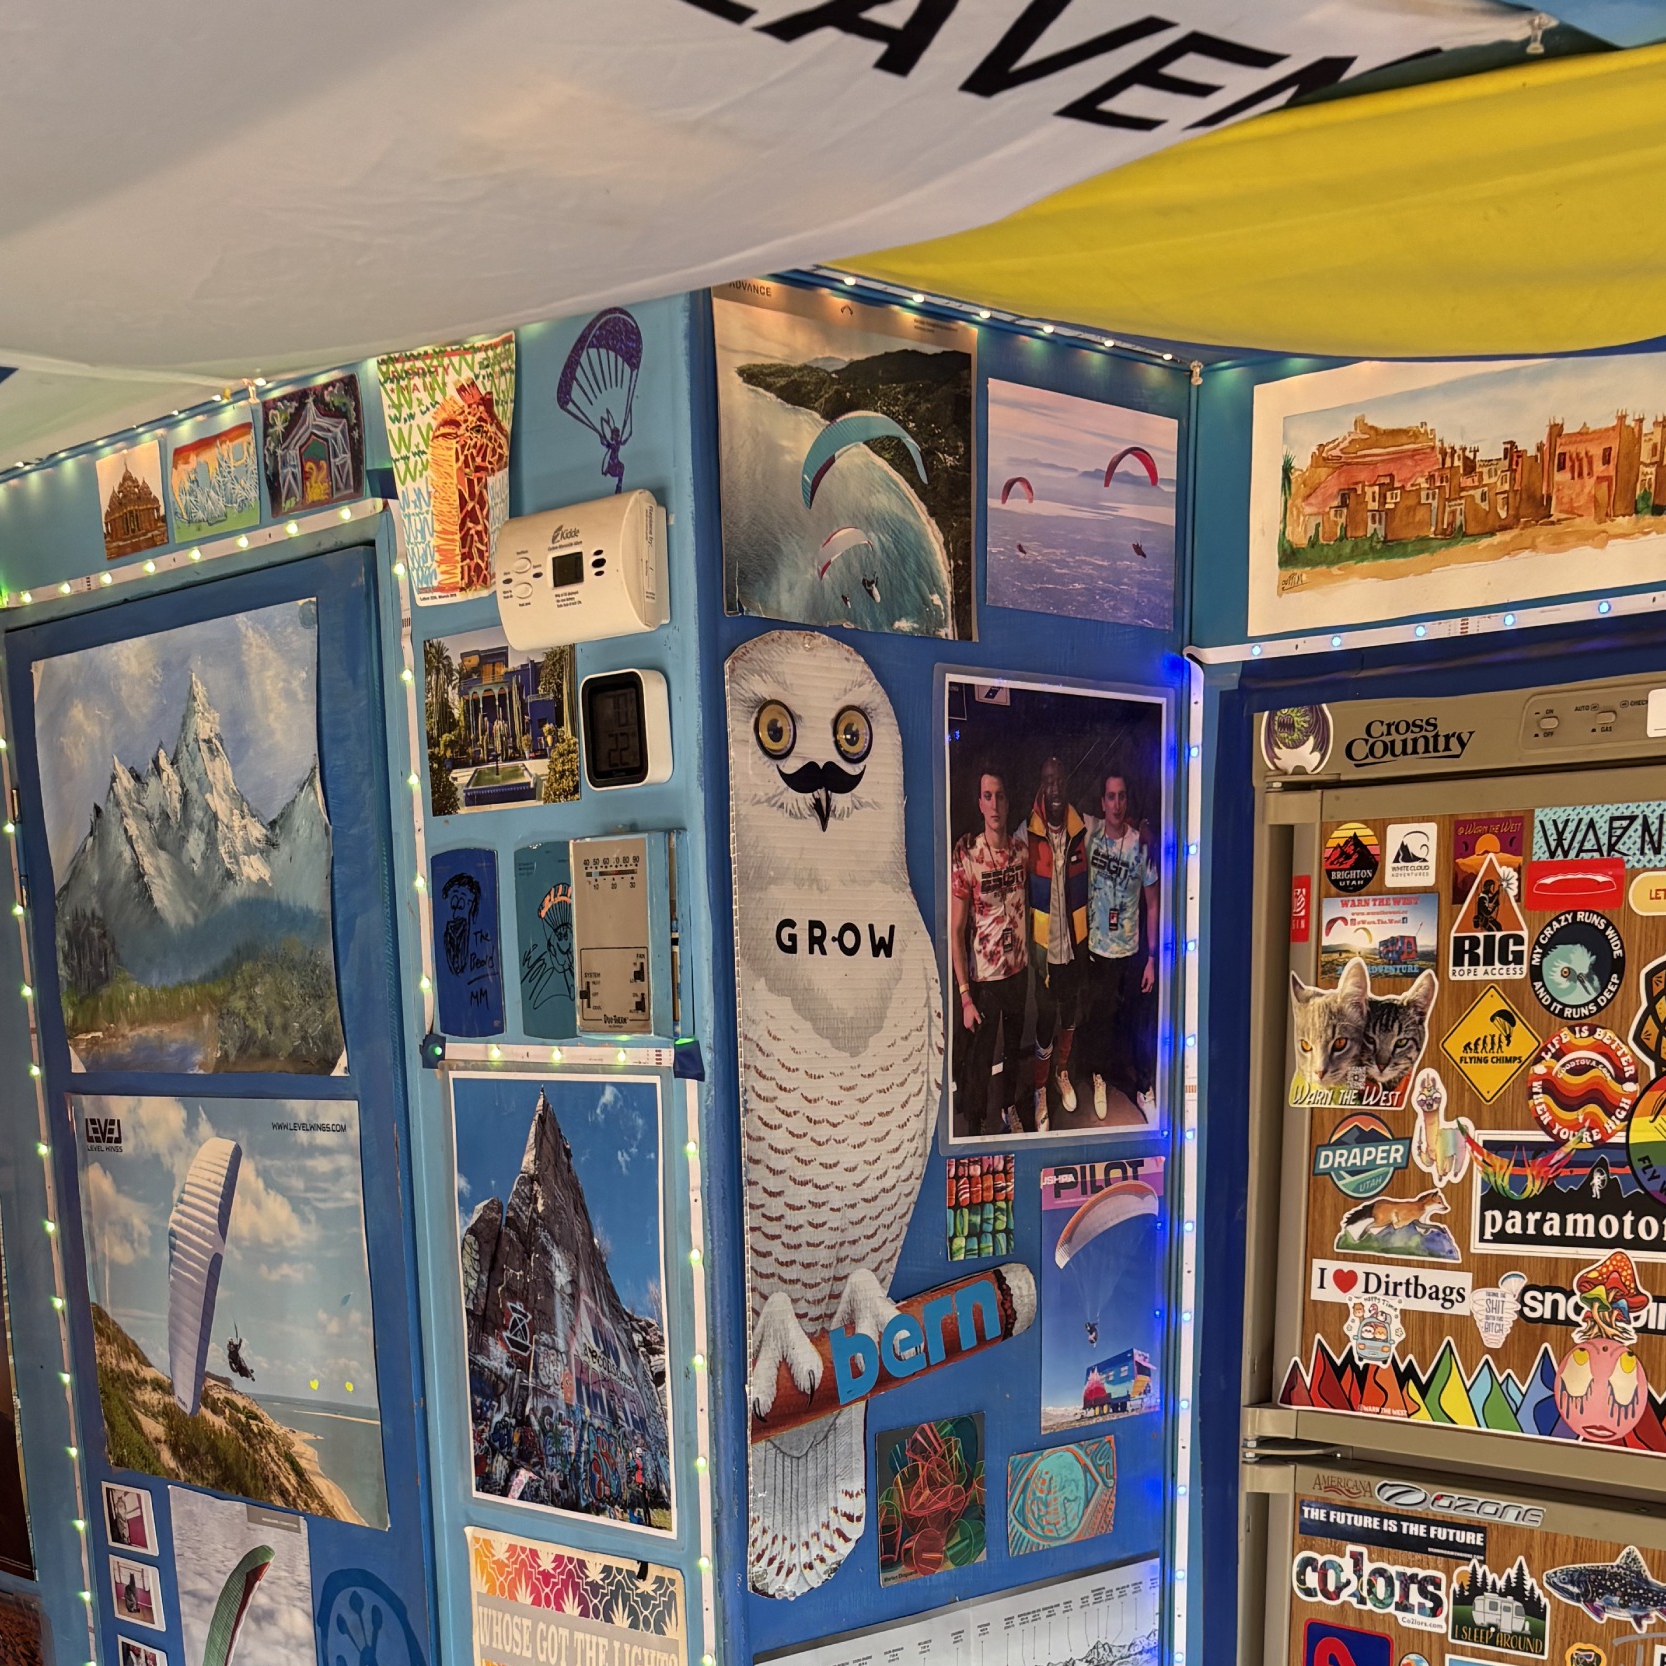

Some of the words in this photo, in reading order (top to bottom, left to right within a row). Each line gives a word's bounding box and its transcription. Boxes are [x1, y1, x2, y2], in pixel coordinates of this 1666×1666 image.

[561, 528, 579, 540] Kidde
[1366, 717, 1438, 738] Cross
[1346, 730, 1475, 765] Country
[623, 856, 630, 864] 80
[1331, 869, 1373, 881] BRIGHTON
[1341, 899, 1369, 908] WARN
[1372, 898, 1390, 907] THE
[1392, 897, 1419, 906] WEST
[473, 930, 491, 945] The
[776, 919, 895, 958] GROW
[1452, 934, 1524, 967] RIG
[1532, 946, 1543, 966] MY
[1539, 912, 1573, 944] CRAZY
[1577, 911, 1607, 929] RUNS
[1605, 926, 1623, 959] WIDE
[469, 948, 495, 972] Beard
[1452, 968, 1479, 977] ROPE
[1483, 967, 1524, 976] ACCESS
[1533, 981, 1551, 1005] AND
[1550, 1002, 1563, 1014] IT
[1563, 1002, 1597, 1018] RUNS
[1597, 974, 1620, 1006] DEEP
[1460, 1056, 1489, 1065] FLYING
[1490, 1055, 1523, 1065] CHIMPS
[1541, 1031, 1570, 1061] LIFE
[1574, 1026, 1589, 1038] IS
[1593, 1028, 1636, 1077] BETTER
[271, 1122, 348, 1133] WWW.LEVELWINGS.COM
[1319, 1144, 1404, 1169] DRAPER
[1053, 1160, 1144, 1198] PILOT
[1318, 1268, 1326, 1289] I
[1363, 1271, 1466, 1309] Dirtbags
[830, 1279, 1003, 1405] bern
[1303, 1506, 1328, 1521] THE
[1329, 1510, 1380, 1532] FUTURE
[1382, 1518, 1398, 1532] IS
[1401, 1520, 1427, 1537] THE
[1429, 1525, 1485, 1547] FUTURE
[478, 1603, 533, 1657] WHOSE
